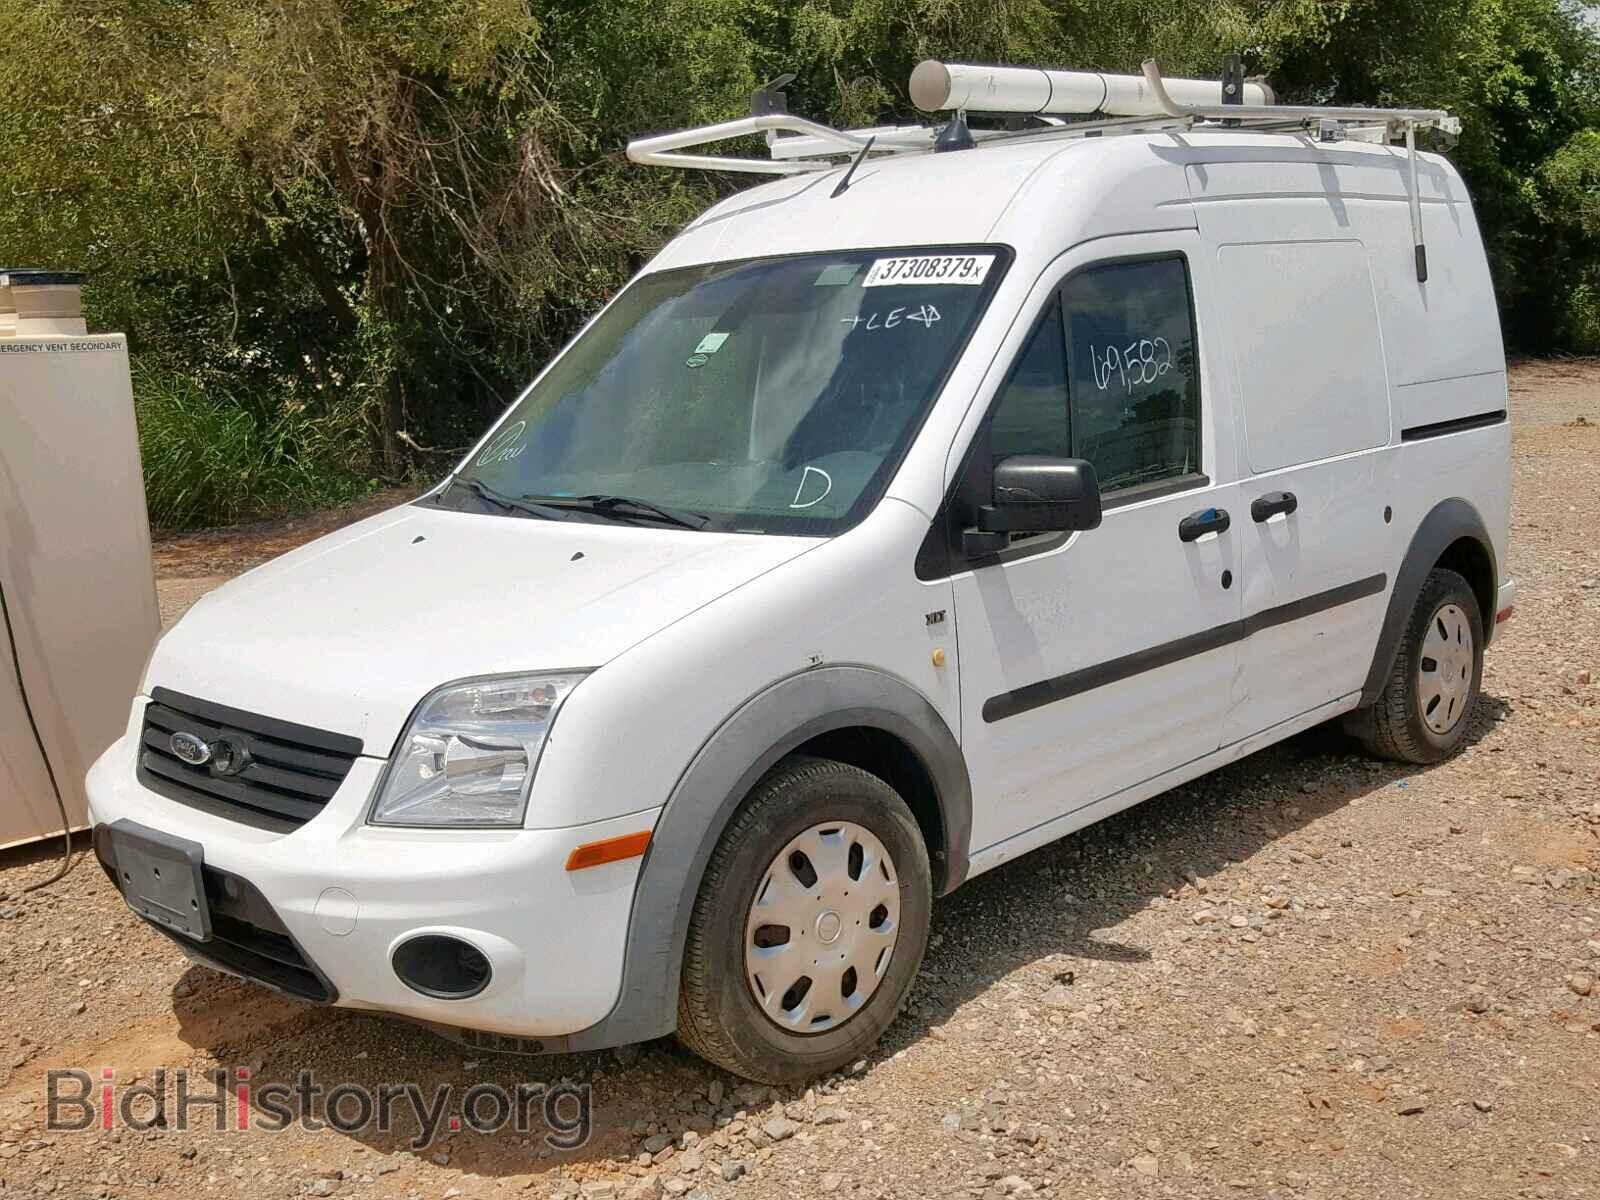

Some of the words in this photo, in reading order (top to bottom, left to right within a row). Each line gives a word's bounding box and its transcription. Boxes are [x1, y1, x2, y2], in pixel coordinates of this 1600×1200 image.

[0, 344, 43, 353] ERGENCY
[45, 343, 68, 352] VENT
[71, 341, 122, 351] SECONDARY
[788, 465, 832, 509] D
